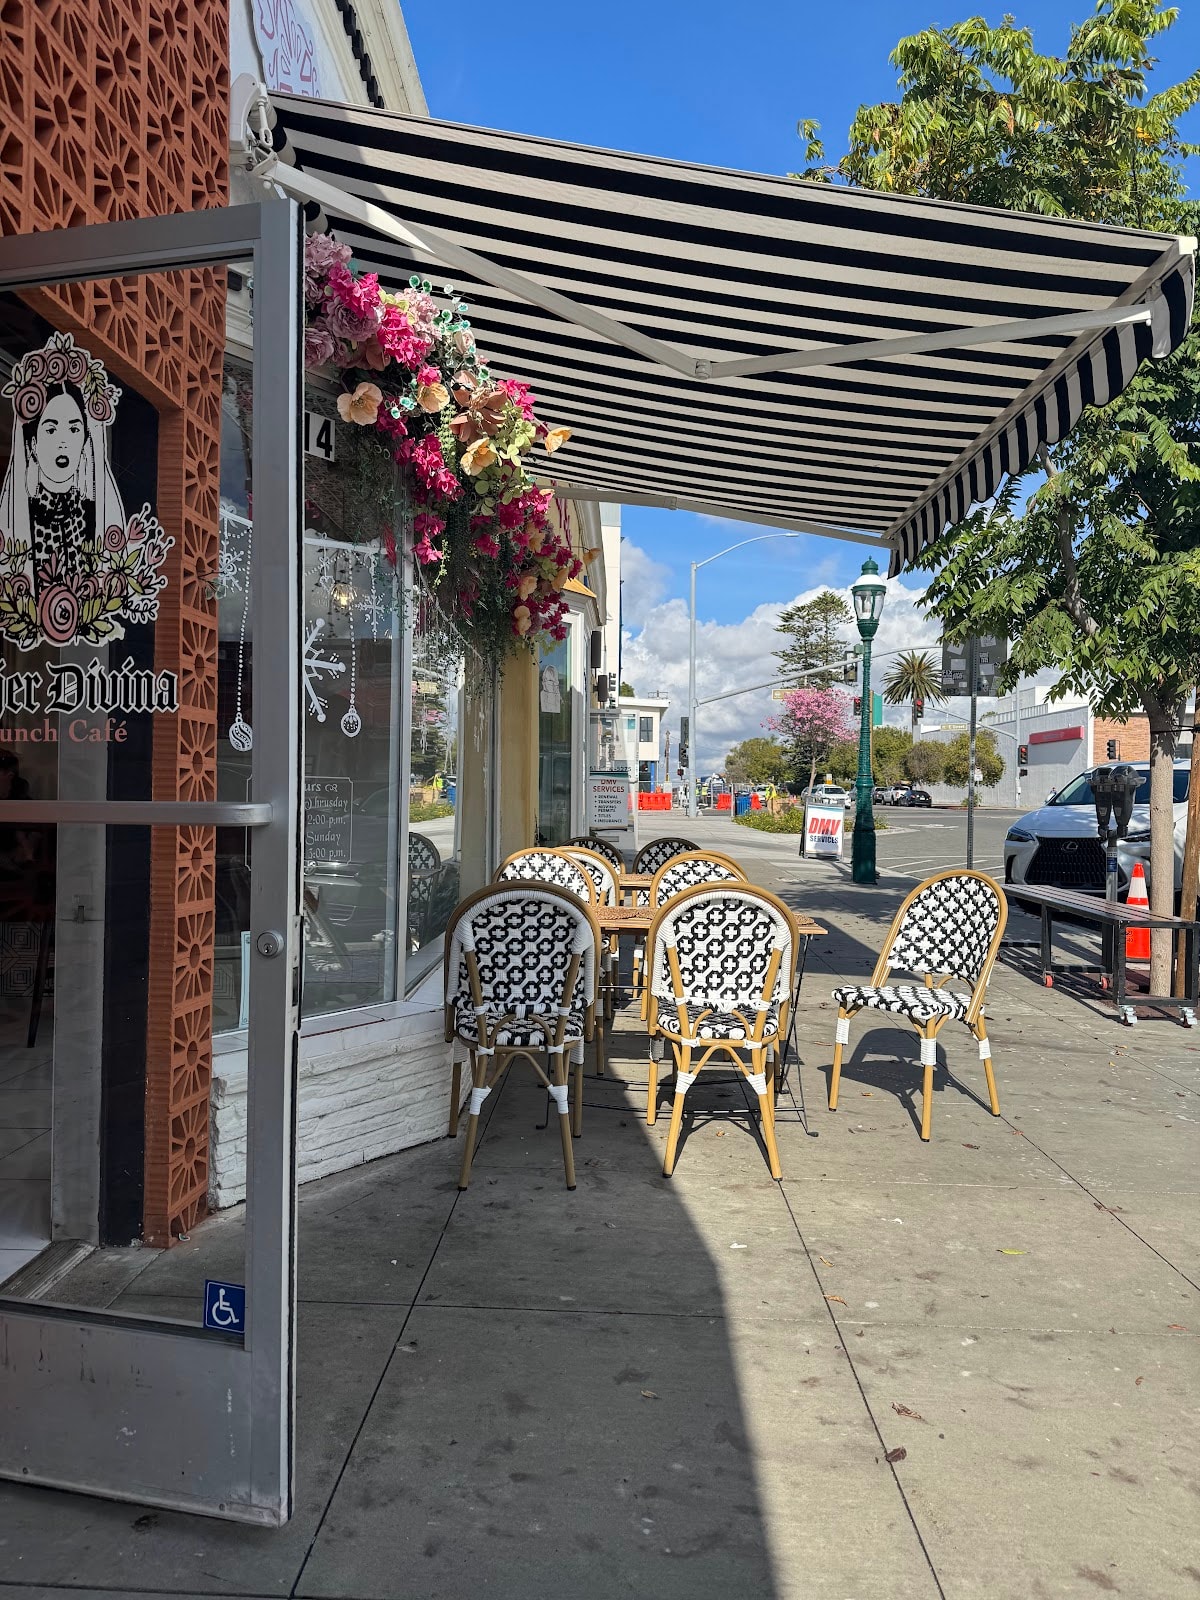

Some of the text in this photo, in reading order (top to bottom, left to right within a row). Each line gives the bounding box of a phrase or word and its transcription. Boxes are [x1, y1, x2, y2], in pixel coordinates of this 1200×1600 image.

[44, 656, 179, 714] Divina
[0, 717, 128, 742] unch Café
[592, 785, 625, 793] SERVICES
[328, 815, 346, 828] p.m.
[808, 818, 841, 835] DMV
[305, 831, 341, 845] Sunday
[810, 835, 838, 843] SERVICES
[328, 848, 346, 861] p.m.
